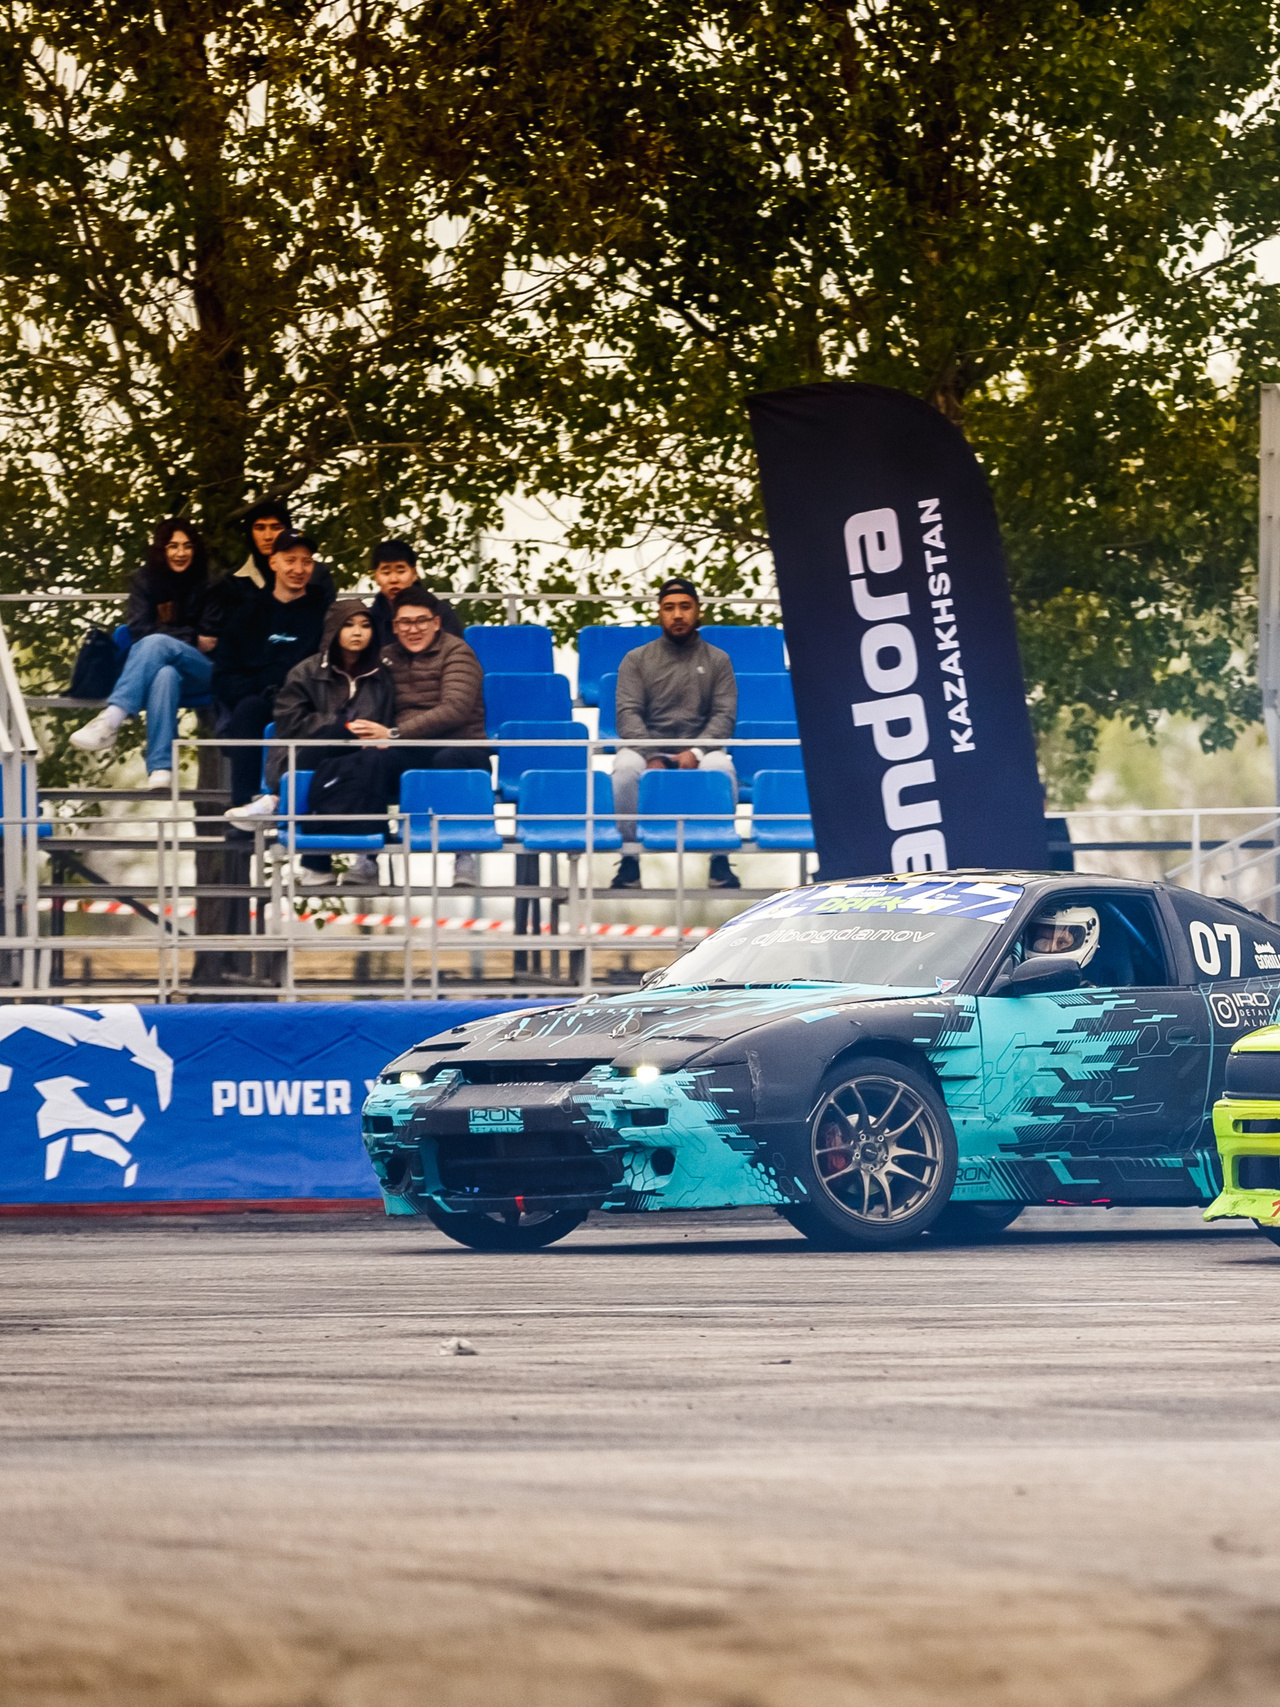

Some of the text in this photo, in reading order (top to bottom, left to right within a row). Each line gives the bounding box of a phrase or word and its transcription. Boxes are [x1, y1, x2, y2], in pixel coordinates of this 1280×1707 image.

[917, 498, 976, 753] KAZAKHSTAN
[751, 926, 936, 947] djbogdanov
[1189, 920, 1241, 978] 07
[212, 1079, 351, 1116] POWER
